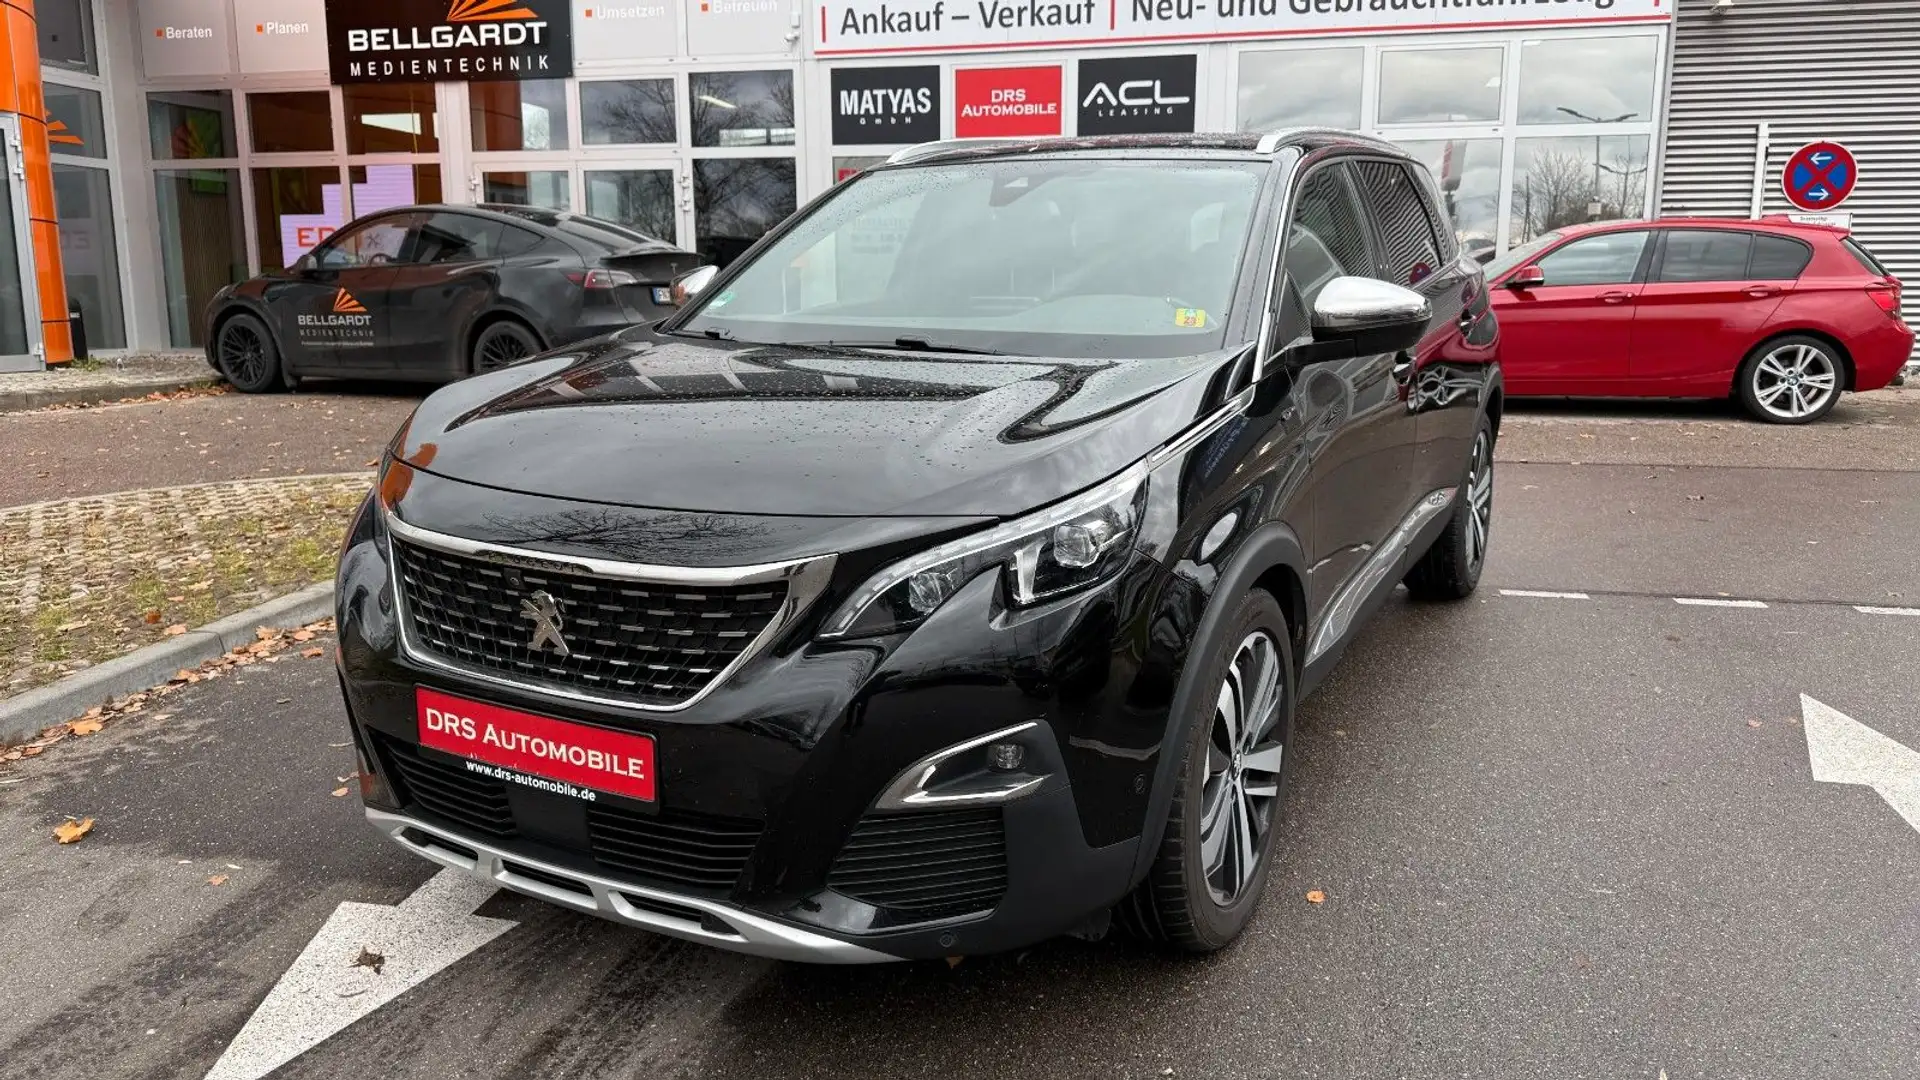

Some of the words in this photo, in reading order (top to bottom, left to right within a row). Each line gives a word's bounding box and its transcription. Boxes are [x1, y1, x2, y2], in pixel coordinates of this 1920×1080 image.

[597, 5, 665, 19] Umsetzen
[840, 2, 944, 35] Ankauf
[978, 0, 1095, 29] Verkauf
[1132, 0, 1206, 21] Neu-
[166, 27, 212, 39] Beraten
[266, 22, 309, 34] Planen
[348, 22, 548, 51] BELLGARDT
[350, 55, 549, 76] MEDIENTECHNIK
[840, 87, 931, 116] MATYAS
[991, 88, 1026, 103] DRS
[1082, 80, 1190, 108] ACL
[1098, 107, 1173, 117] LEASING
[298, 315, 372, 326] BELLGARDT
[426, 708, 477, 740] DRS
[465, 761, 596, 801] www.drs-automobile.de
